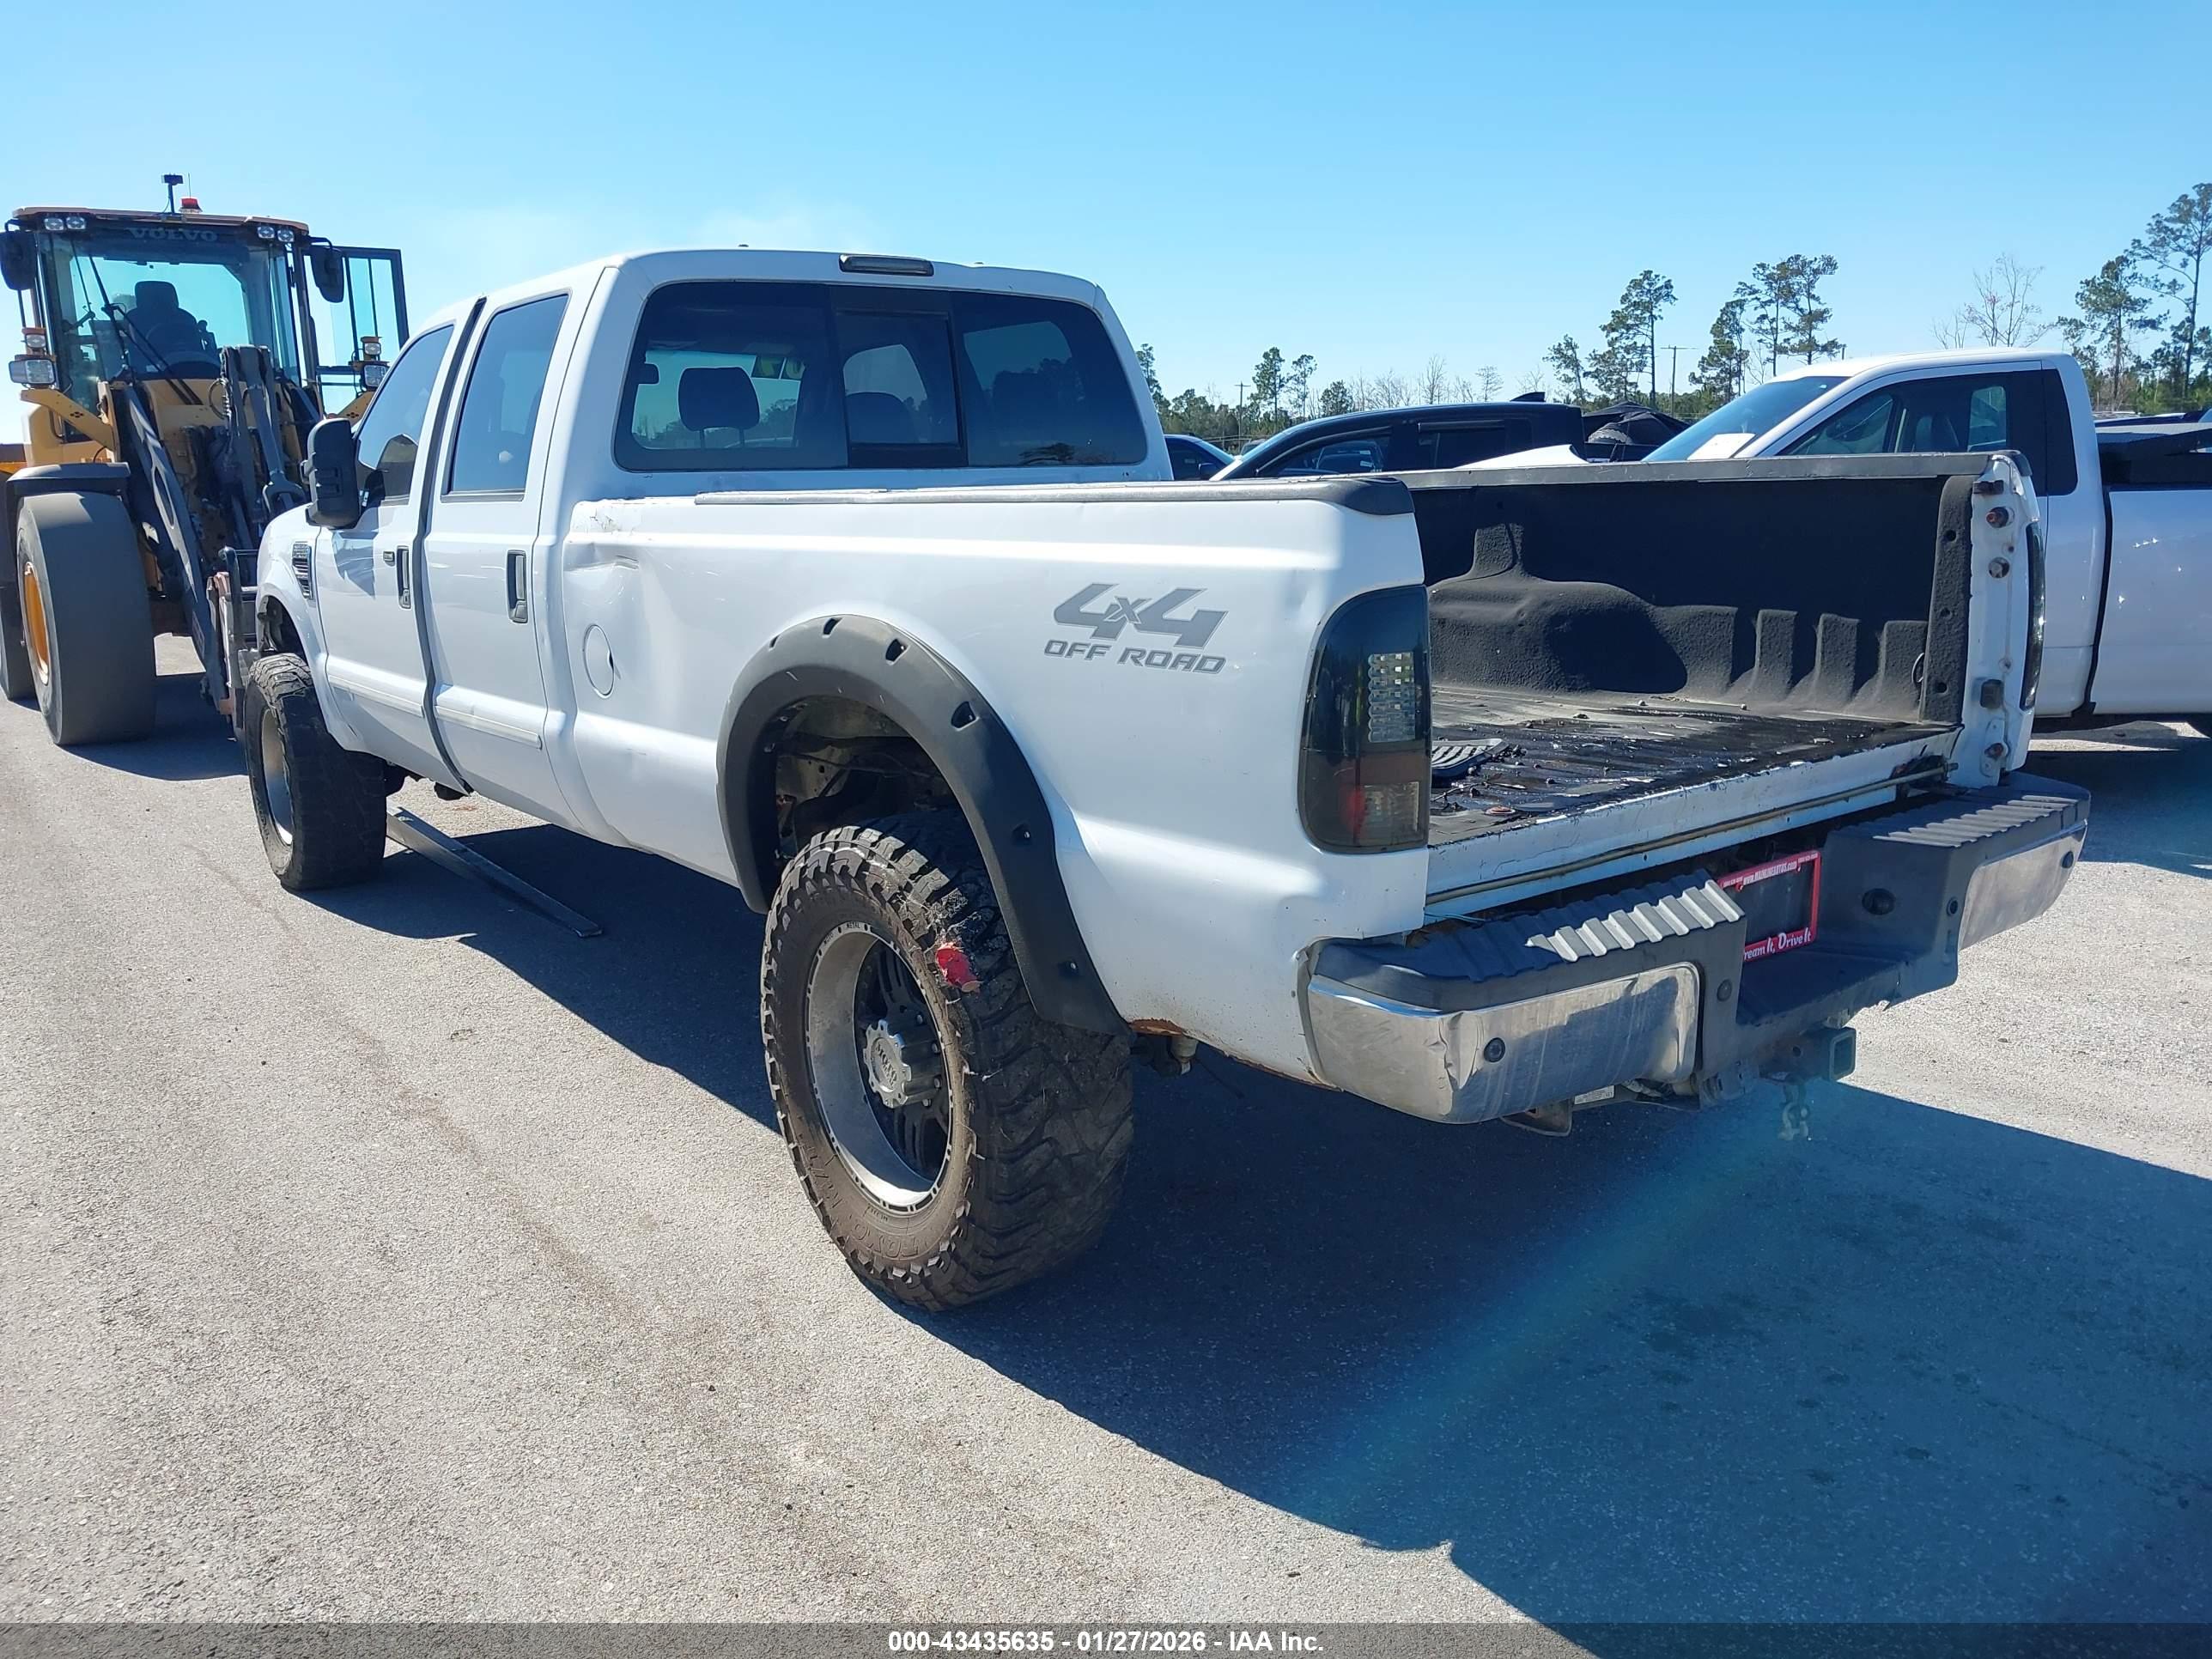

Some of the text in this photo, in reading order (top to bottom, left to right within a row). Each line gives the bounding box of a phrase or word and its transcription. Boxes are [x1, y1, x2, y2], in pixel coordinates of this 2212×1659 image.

[124, 227, 218, 241] VOLVO
[1043, 640, 1227, 674] OFF ROAD
[1744, 927, 1812, 960] ream It, Drive It
